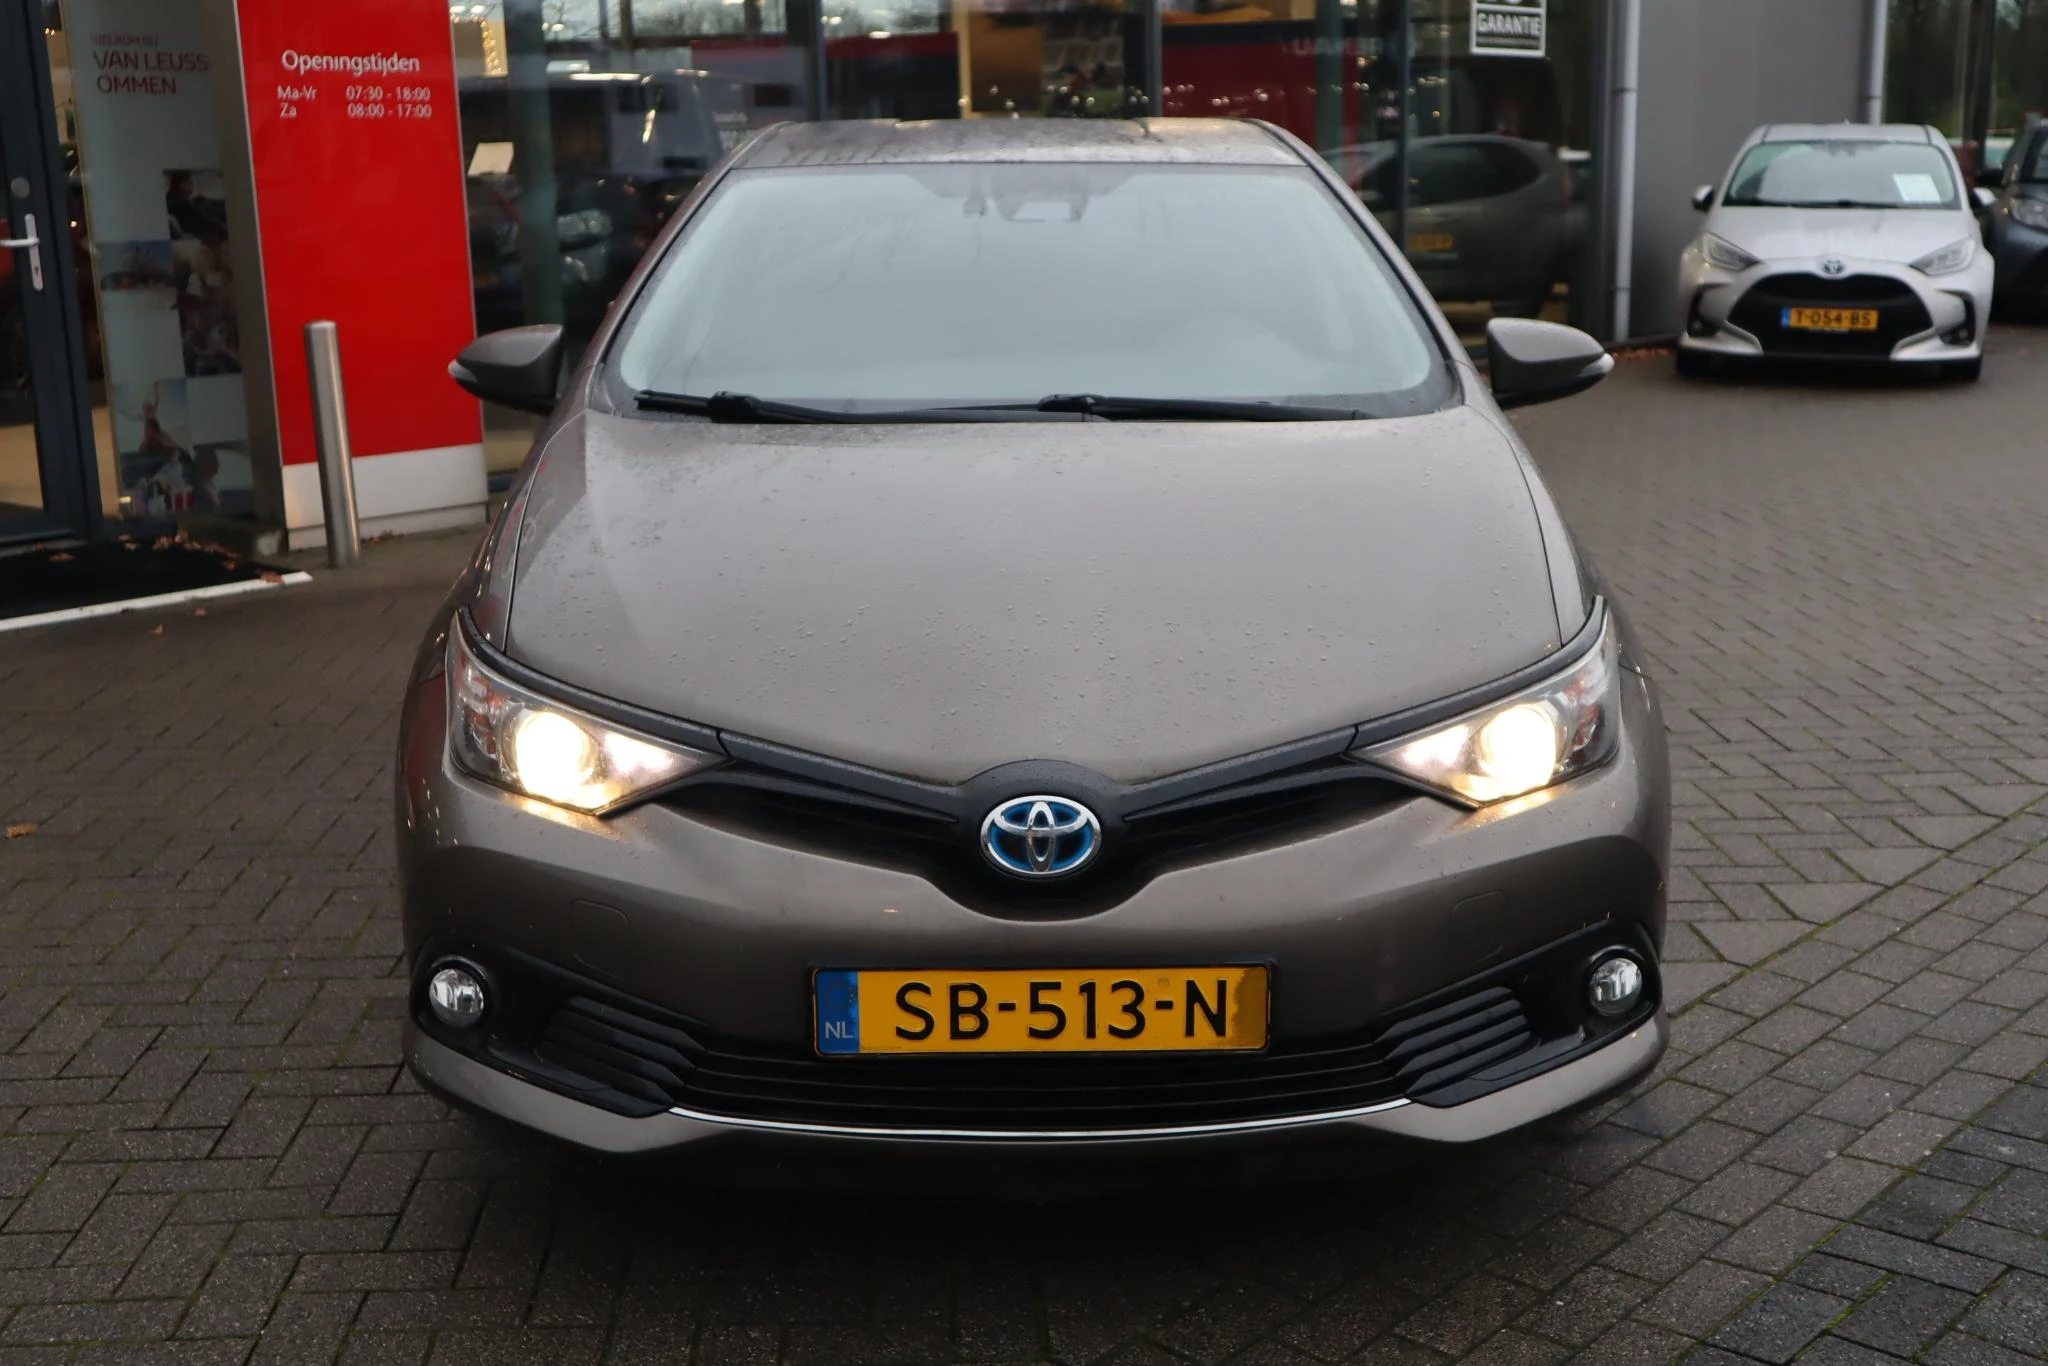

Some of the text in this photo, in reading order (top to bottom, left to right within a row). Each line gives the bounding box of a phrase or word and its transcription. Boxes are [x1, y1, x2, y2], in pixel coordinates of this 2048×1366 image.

[1478, 12, 1541, 36] GARANTIE
[93, 50, 210, 72] VAN LEUSS
[281, 50, 420, 77] Openingstijden
[96, 75, 177, 95] OMMEN
[277, 84, 317, 100] Ma-Vr
[345, 85, 383, 101] 07:30
[396, 86, 431, 101] 18:00
[280, 102, 297, 118] Za
[347, 102, 385, 118] 08:00
[397, 103, 432, 118] 17:00
[1795, 309, 1873, 327] T-054-BS
[895, 979, 1228, 1041] SB-513-N
[824, 1021, 854, 1039] NL
